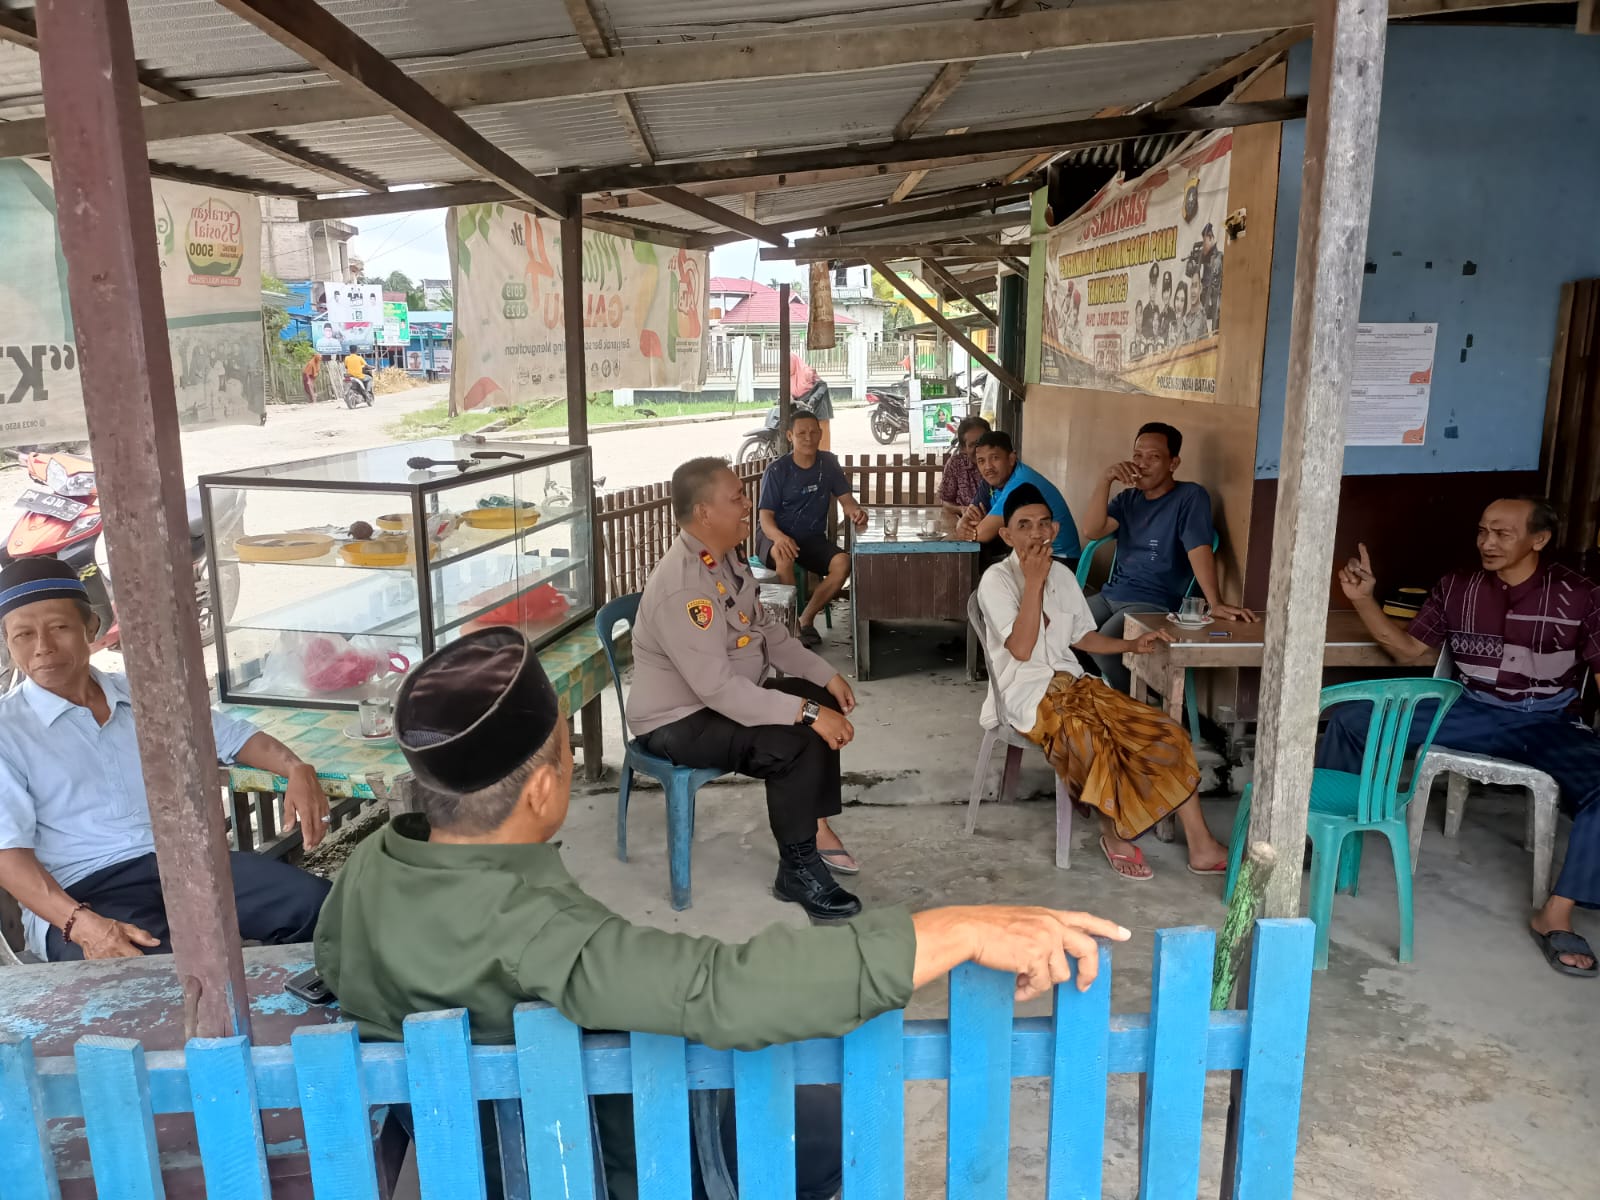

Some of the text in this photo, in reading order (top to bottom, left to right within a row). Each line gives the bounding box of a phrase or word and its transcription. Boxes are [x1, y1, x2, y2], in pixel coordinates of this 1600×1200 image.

[1081, 190, 1152, 241] SIALISASI
[1150, 224, 1179, 263] POLRI
[1087, 276, 1111, 307] TAHUN
